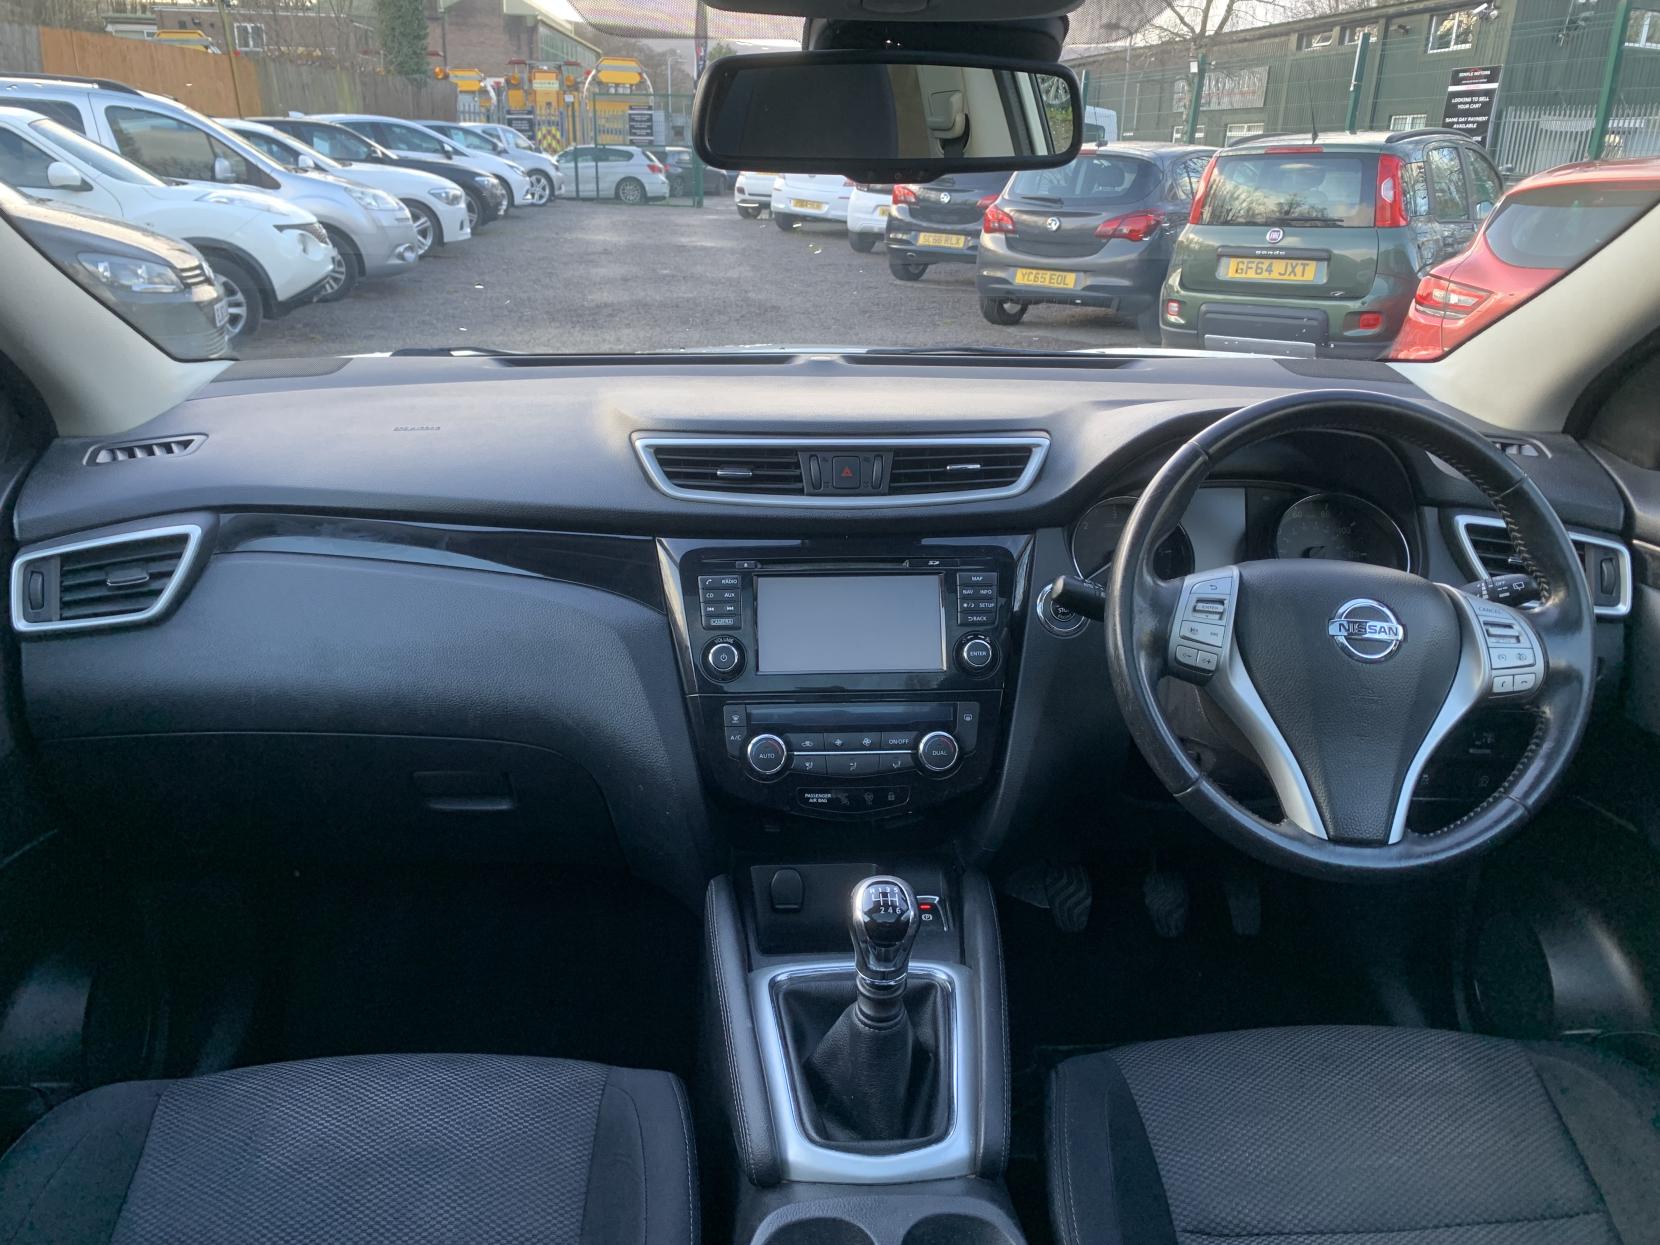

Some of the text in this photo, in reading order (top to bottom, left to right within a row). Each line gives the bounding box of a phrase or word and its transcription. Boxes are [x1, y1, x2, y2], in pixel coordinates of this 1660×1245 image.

[1234, 260, 1309, 277] GF64 JXT
[1021, 271, 1069, 286] YC65 EOL
[1338, 622, 1399, 637] NISSAN
